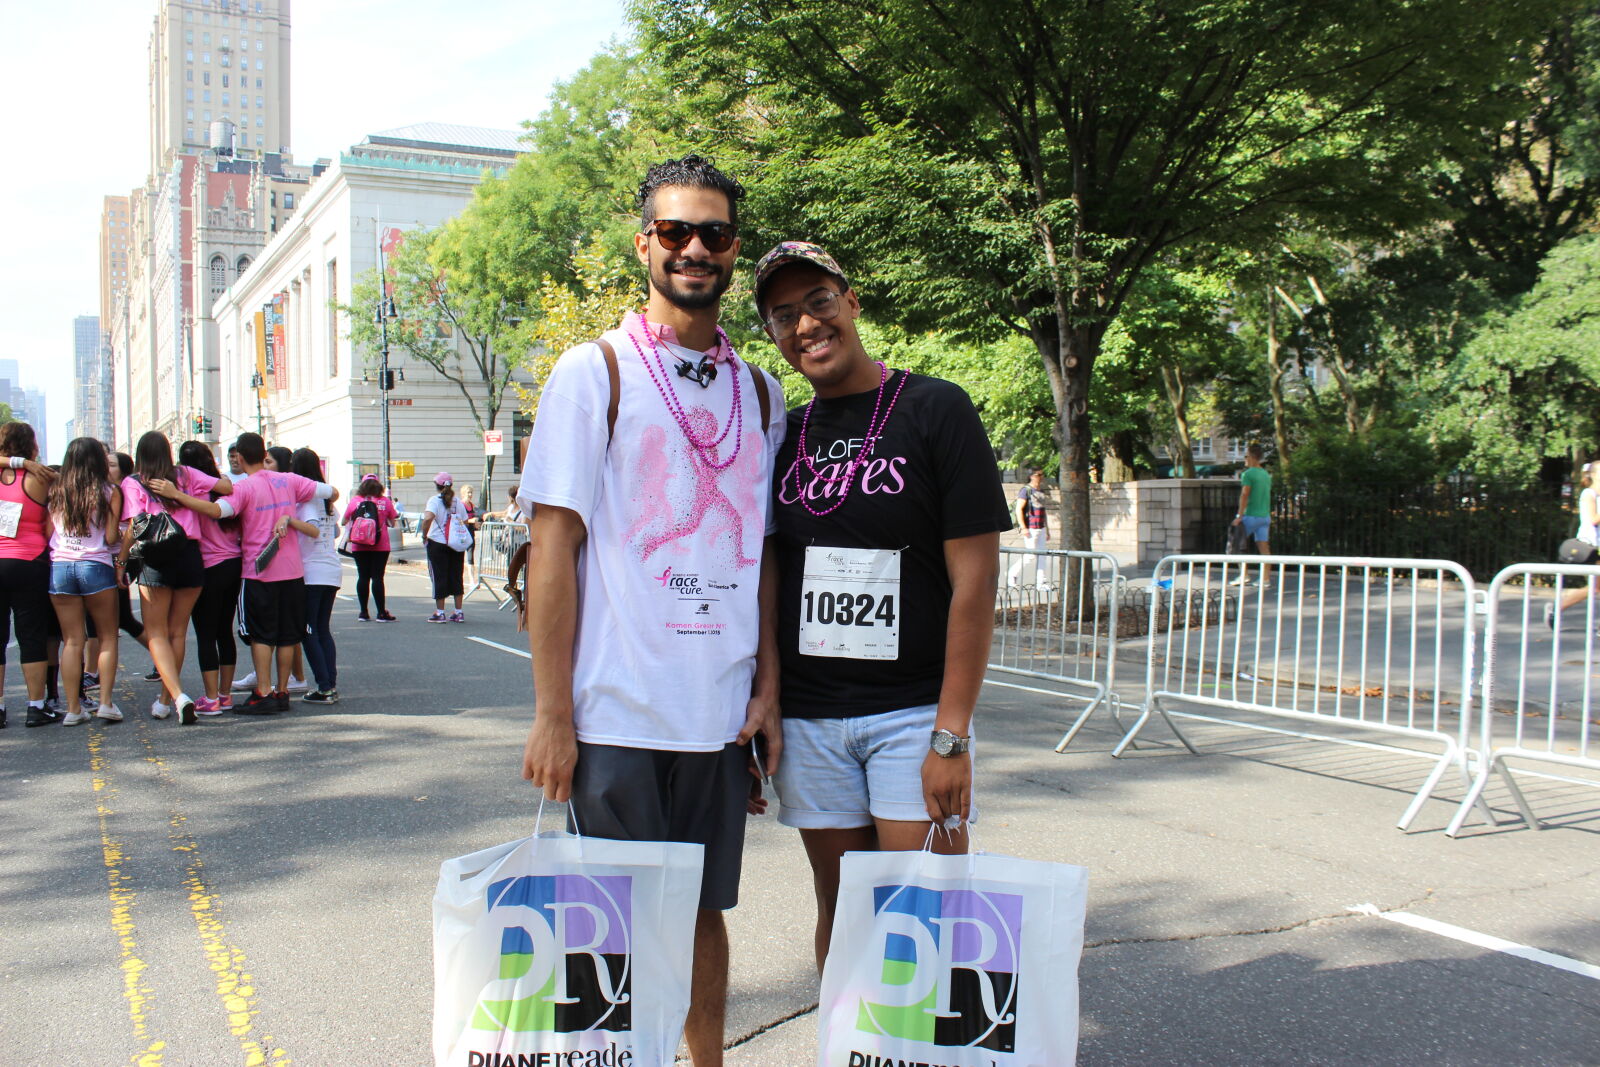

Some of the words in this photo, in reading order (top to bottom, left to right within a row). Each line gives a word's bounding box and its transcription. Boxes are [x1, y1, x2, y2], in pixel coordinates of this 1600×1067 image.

[264, 304, 274, 335] TRICORNE
[265, 335, 275, 344] LE
[815, 436, 883, 463] LOFT
[779, 456, 907, 505] Cares
[669, 577, 699, 587] race
[680, 587, 703, 595] cure.
[804, 591, 896, 628] 10324
[555, 1042, 632, 1067] reade
